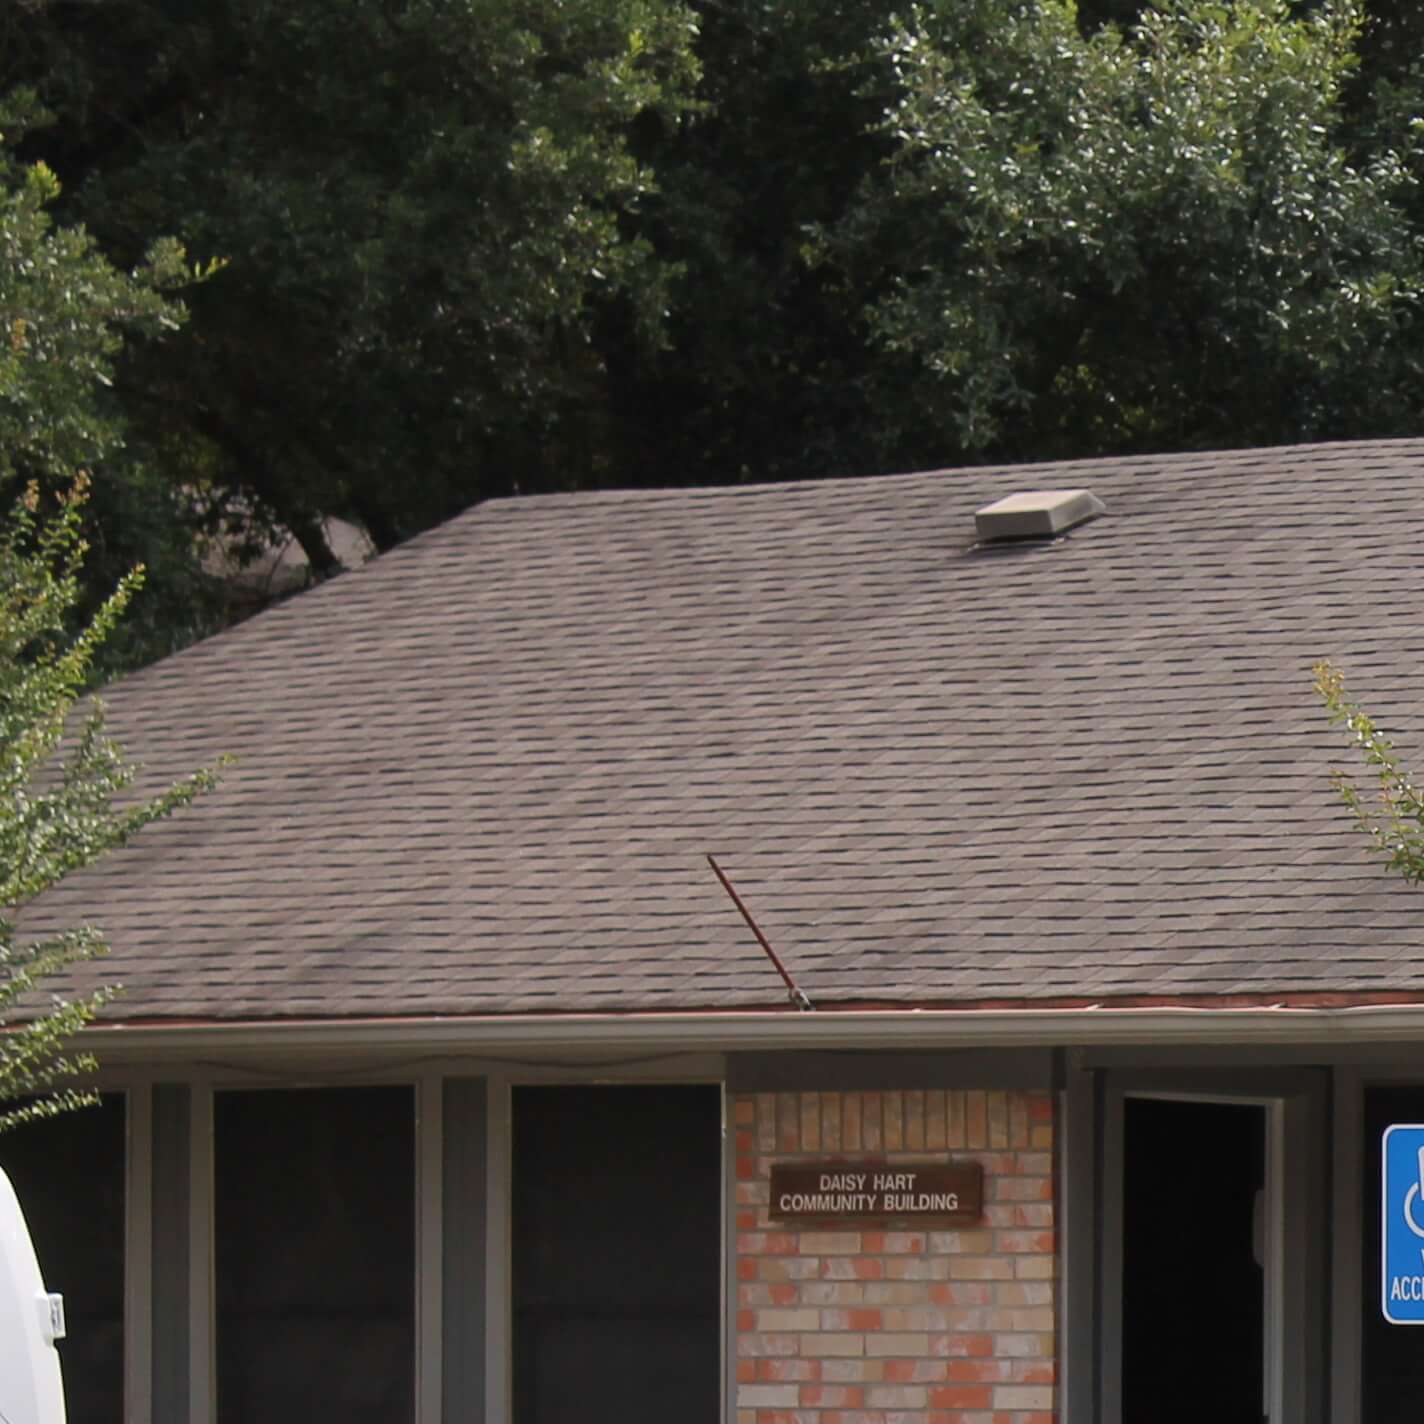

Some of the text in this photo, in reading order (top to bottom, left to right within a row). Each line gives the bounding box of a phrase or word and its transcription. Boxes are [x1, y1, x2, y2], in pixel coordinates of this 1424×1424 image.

[820, 1173, 916, 1192] DAISY HART
[780, 1193, 958, 1211] COMMUNITY BUILDING
